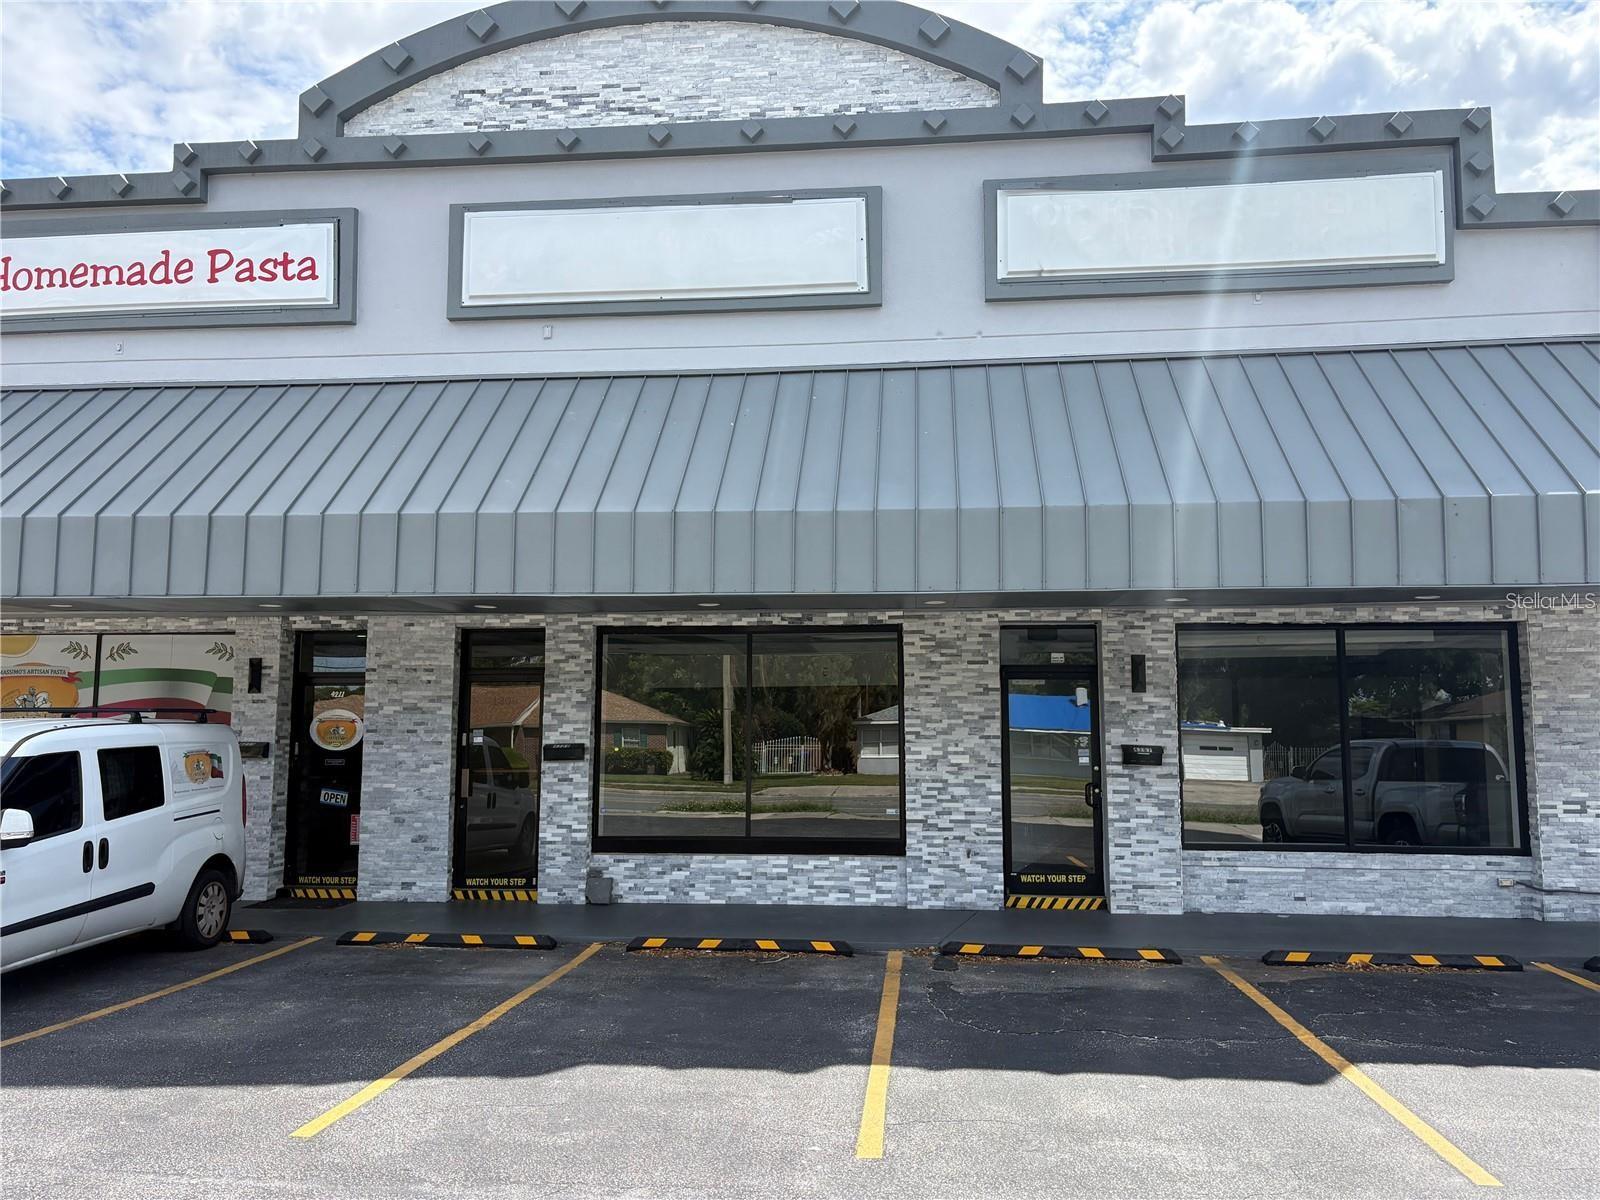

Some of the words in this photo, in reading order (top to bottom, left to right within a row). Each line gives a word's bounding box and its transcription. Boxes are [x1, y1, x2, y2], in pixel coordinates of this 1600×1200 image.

[208, 249, 318, 283] Pasta
[323, 792, 347, 804] OPEN
[298, 876, 321, 885] WATCH
[321, 876, 340, 885] YOUR
[340, 876, 357, 885] STEP
[465, 877, 489, 886] WATCH
[490, 877, 509, 886] YOUR
[509, 877, 527, 886] STEP
[1020, 874, 1046, 883] WATCH
[1046, 874, 1067, 883] YOUR
[1067, 874, 1087, 883] STEP
